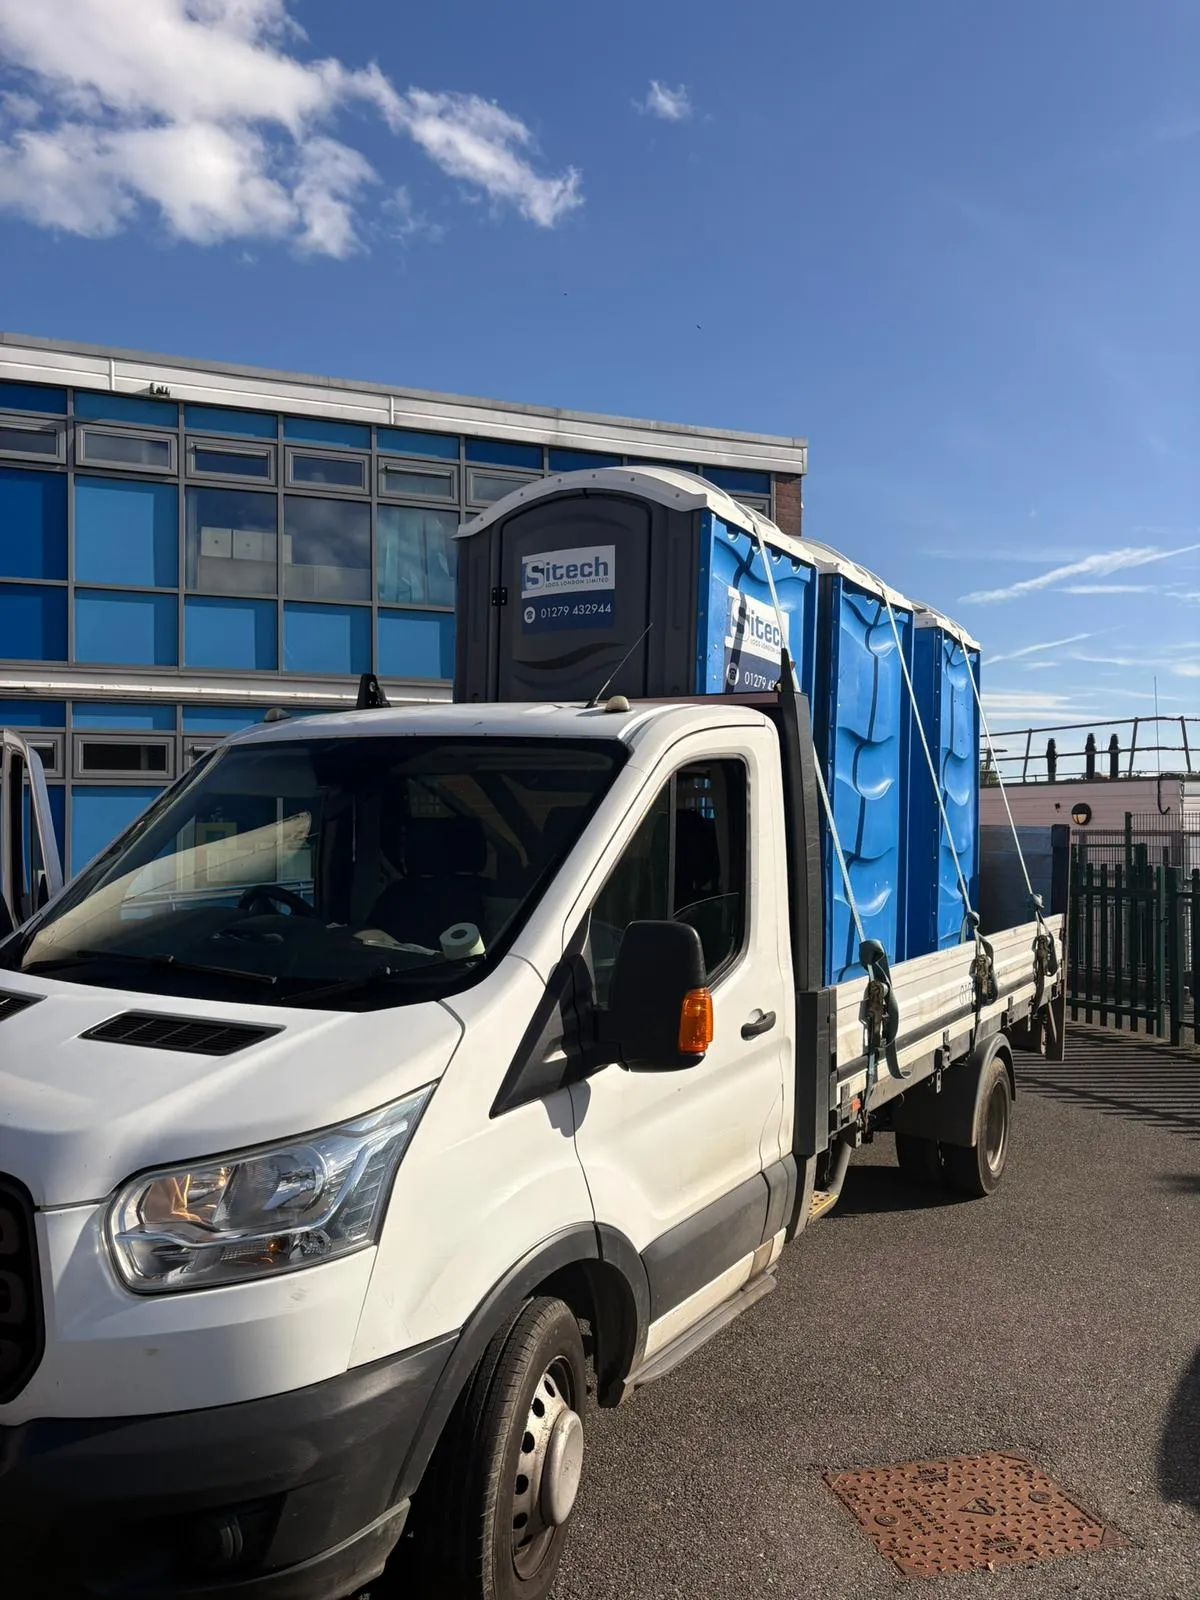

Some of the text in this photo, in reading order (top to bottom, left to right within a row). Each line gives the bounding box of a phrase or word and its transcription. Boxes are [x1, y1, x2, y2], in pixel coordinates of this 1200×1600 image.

[525, 556, 608, 590] Sitech
[560, 578, 584, 586] LONDON
[586, 576, 609, 584] LIMITED
[540, 602, 612, 618] 01279 432944
[744, 671, 767, 690] 01279
